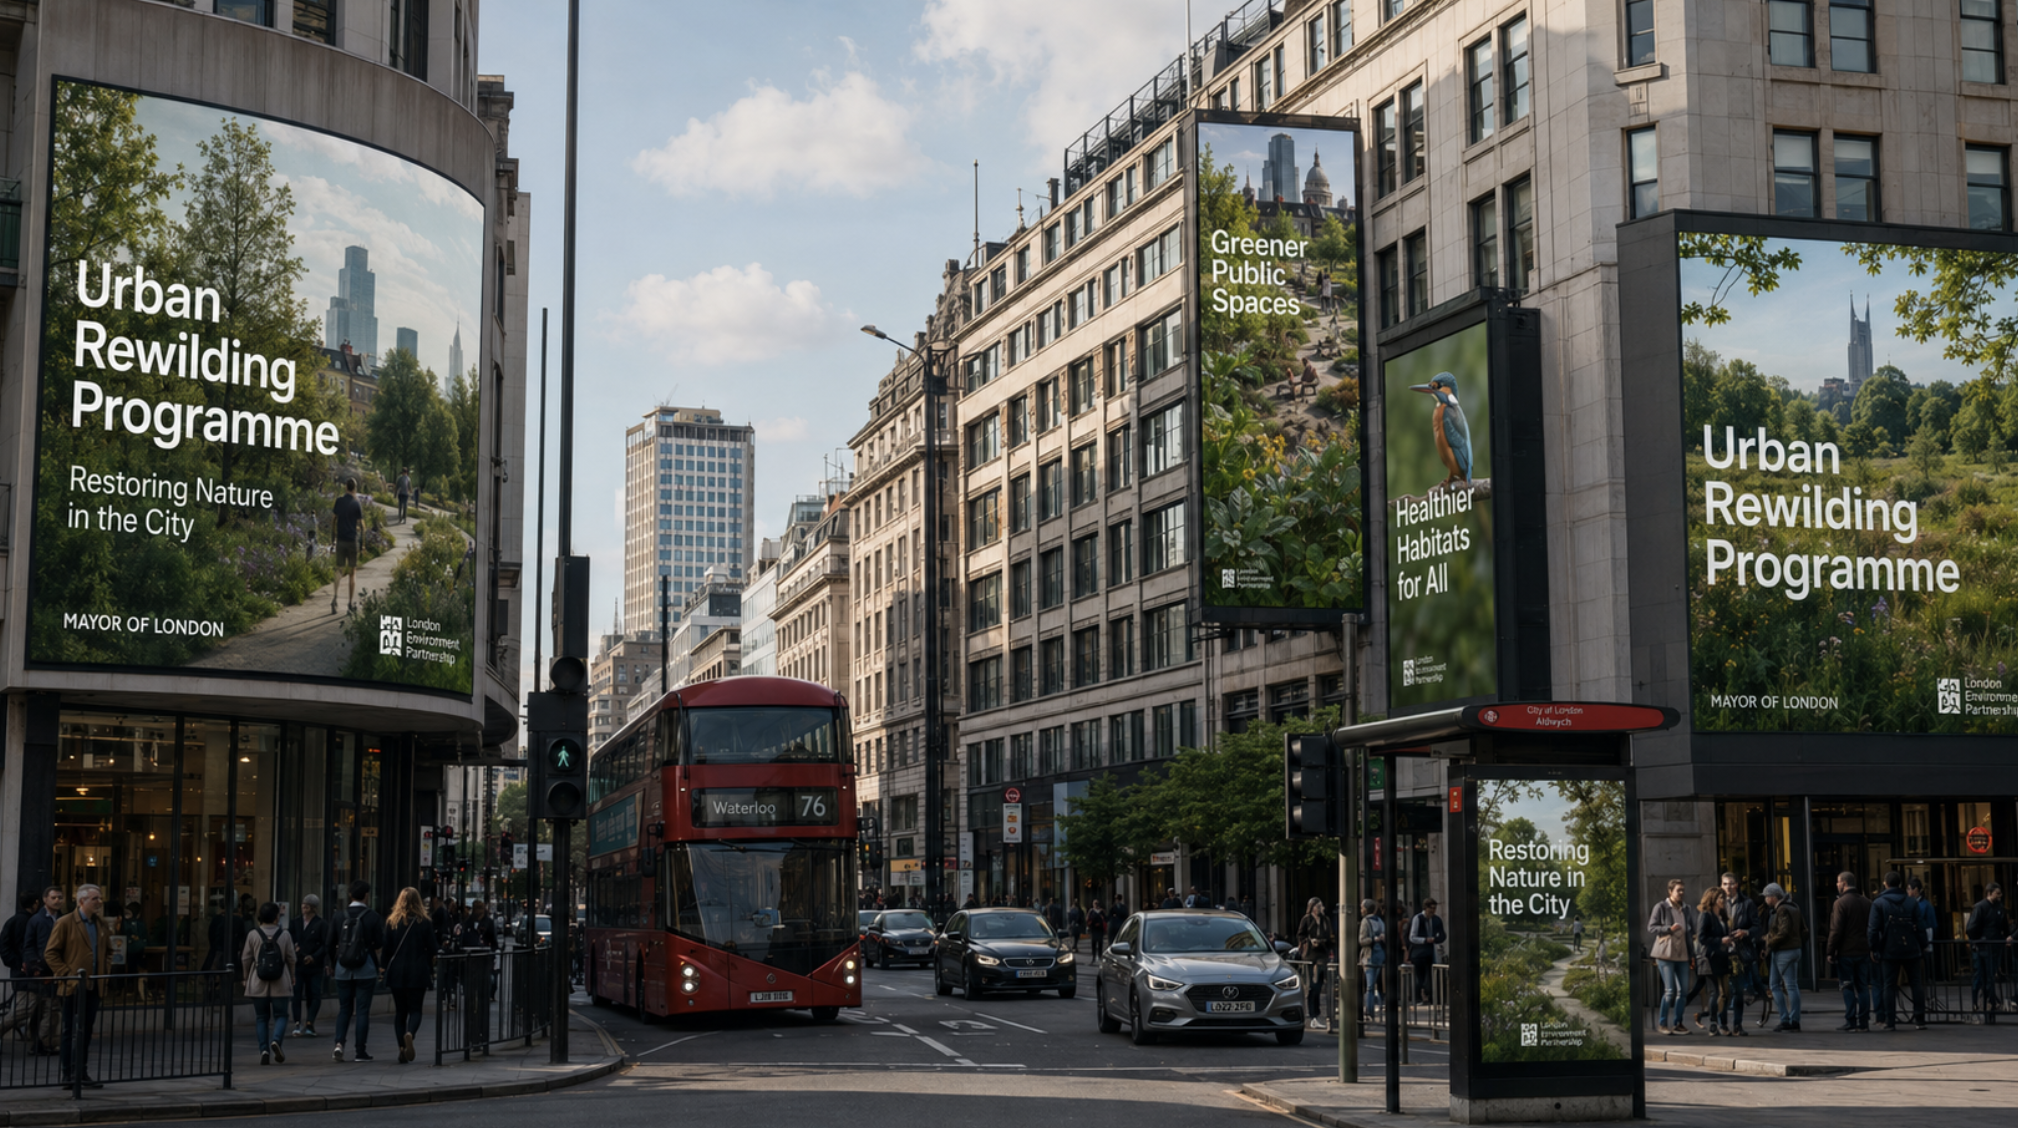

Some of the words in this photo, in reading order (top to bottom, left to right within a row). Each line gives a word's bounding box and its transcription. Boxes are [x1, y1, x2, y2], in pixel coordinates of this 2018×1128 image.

[1212, 229, 1309, 258] Greener
[1212, 259, 1286, 285] Public
[77, 259, 220, 323] Urban
[1212, 288, 1301, 319] Spaces
[75, 319, 296, 403] Rewilding
[72, 380, 339, 456] Programme
[1703, 424, 1840, 474] Urban
[70, 465, 188, 507] Restoring
[196, 477, 273, 508] Nature
[67, 502, 90, 530] in
[97, 504, 138, 533] the
[145, 508, 195, 543] City
[1396, 484, 1475, 528] Healthier
[1705, 480, 1918, 544] Rewilding
[1397, 524, 1471, 565] Habitats
[1397, 571, 1422, 601] for
[1425, 562, 1449, 596] All
[1706, 539, 1961, 600] Programme
[63, 612, 122, 632] MAYOR
[127, 616, 149, 633] OF
[154, 617, 224, 637] LONDON
[406, 616, 441, 632] London
[1964, 676, 2002, 689] London
[1711, 694, 1758, 709] MAYOR
[1761, 694, 1779, 709] OF
[1783, 695, 1839, 710] LONDON
[712, 800, 776, 815] Waterloo
[801, 795, 827, 817] 76
[1489, 839, 1589, 866] Restoring
[1489, 865, 1562, 888] Nature
[1567, 865, 1586, 888] in
[1488, 892, 1524, 915] the
[1529, 892, 1571, 920] City
